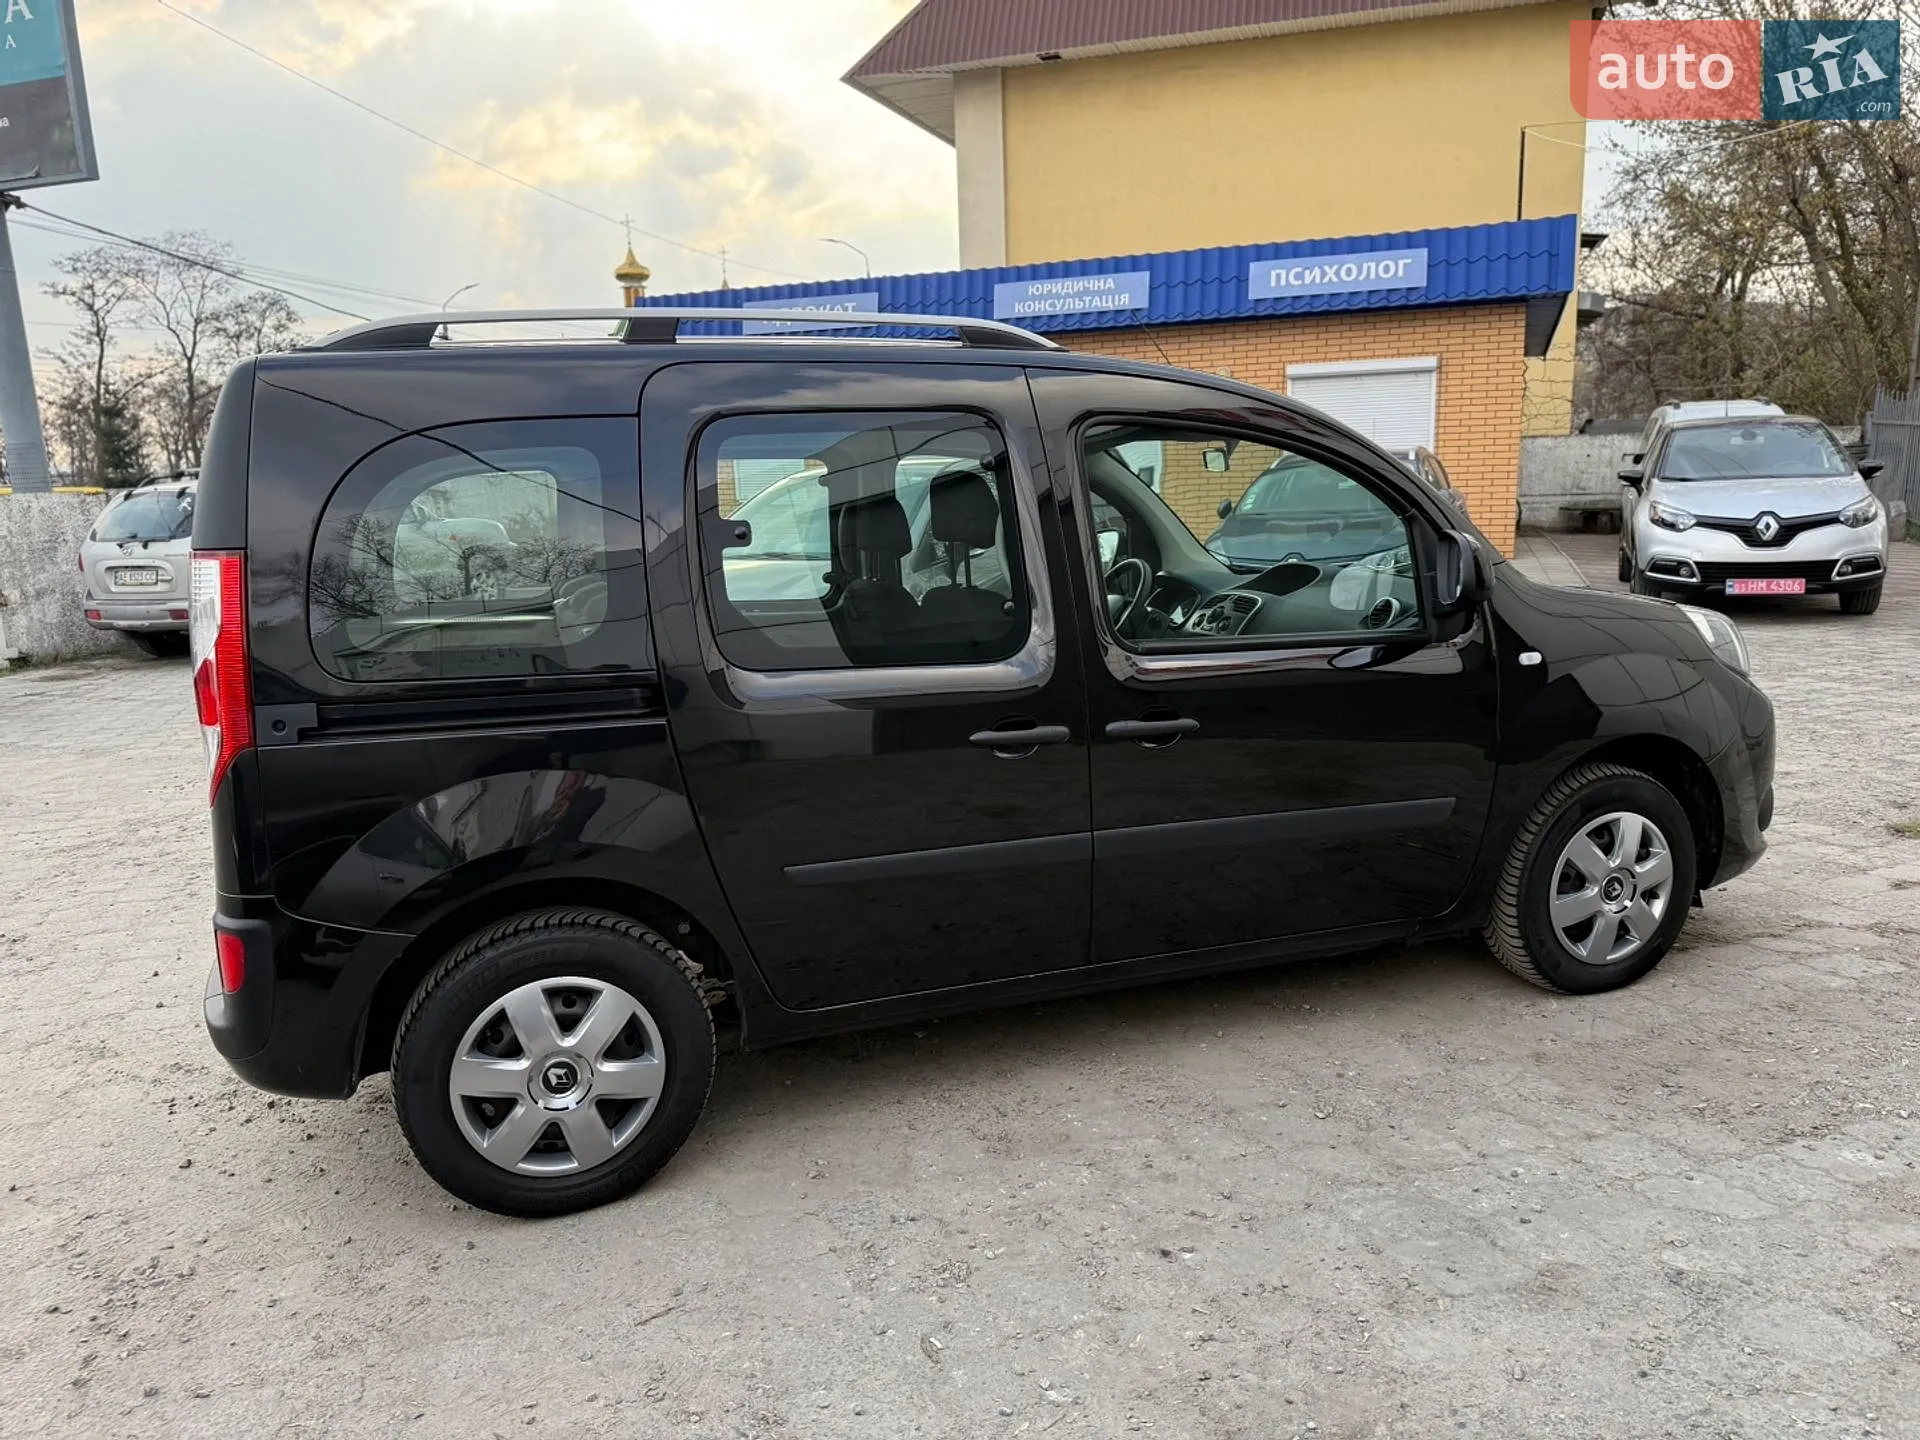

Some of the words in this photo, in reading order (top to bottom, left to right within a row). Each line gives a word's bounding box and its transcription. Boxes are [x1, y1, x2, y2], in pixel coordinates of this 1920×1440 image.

[1270, 259, 1412, 287] ПСИХОЛОГ
[1028, 278, 1115, 296] ЮРИДИЧНА
[1014, 293, 1129, 313] КОНСУЛЬТАЦІЯ
[1771, 580, 1800, 591] 4306
